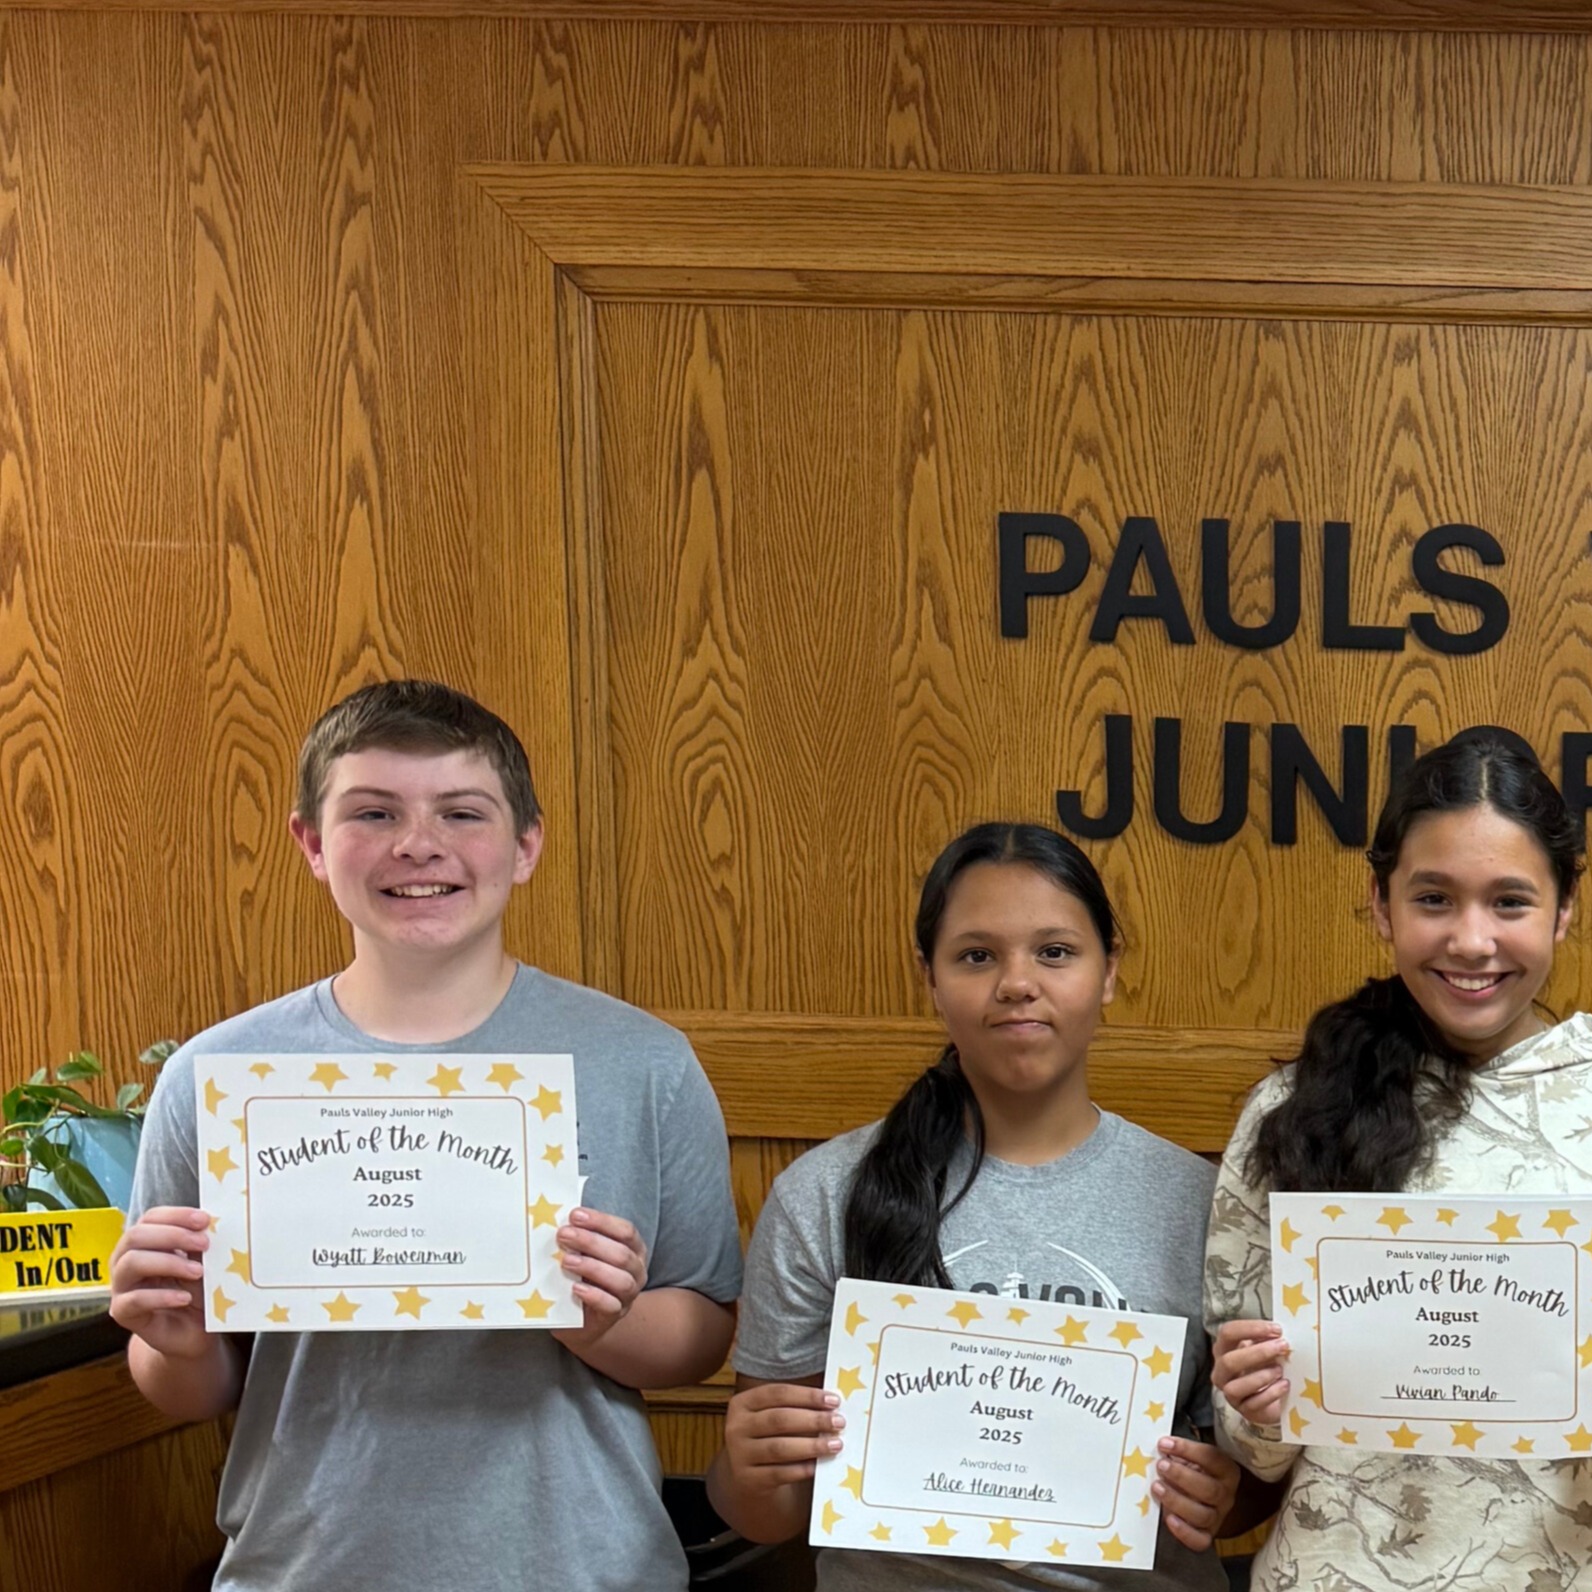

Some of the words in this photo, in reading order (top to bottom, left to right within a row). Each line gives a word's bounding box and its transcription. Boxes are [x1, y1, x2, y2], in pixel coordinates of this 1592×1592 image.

[997, 510, 1510, 655] PAULS
[320, 1107, 350, 1117] Pauls
[352, 1107, 387, 1119] Valley
[389, 1107, 426, 1118] Junior
[428, 1107, 453, 1119] High
[257, 1128, 352, 1177] Student
[357, 1127, 381, 1154] of
[387, 1125, 429, 1151] the
[437, 1130, 518, 1176] Month
[353, 1166, 423, 1184] August
[367, 1193, 414, 1208] 2025
[351, 1226, 408, 1239] Awarded
[312, 1248, 367, 1267] Wyatt
[372, 1247, 467, 1266] Bowerman
[1386, 1250, 1414, 1259] Pauls
[1416, 1251, 1449, 1262] Valley
[1450, 1252, 1483, 1262] Junior
[1486, 1253, 1510, 1264] High
[15, 1257, 103, 1288] In/Out
[1327, 1270, 1414, 1313] Student
[1419, 1269, 1444, 1295] of
[1449, 1269, 1487, 1294] the
[1494, 1275, 1569, 1317] Month
[1415, 1307, 1479, 1325] August
[1428, 1333, 1472, 1349] 2025
[950, 1342, 979, 1355] Pauls
[980, 1345, 1012, 1360] Valley
[1014, 1349, 1047, 1363] Junior
[1049, 1354, 1073, 1366] High
[1413, 1364, 1464, 1376] Awarded
[884, 1364, 973, 1400] Student
[979, 1365, 1005, 1389] of
[1009, 1366, 1045, 1393] the
[1051, 1377, 1122, 1426] Month
[1395, 1383, 1447, 1401] Vivian
[970, 1400, 1034, 1421] August
[979, 1428, 1023, 1445] 2025
[959, 1457, 1012, 1472] Awarded
[922, 1472, 966, 1494] Alice
[971, 1477, 1055, 1502] Hernandez
